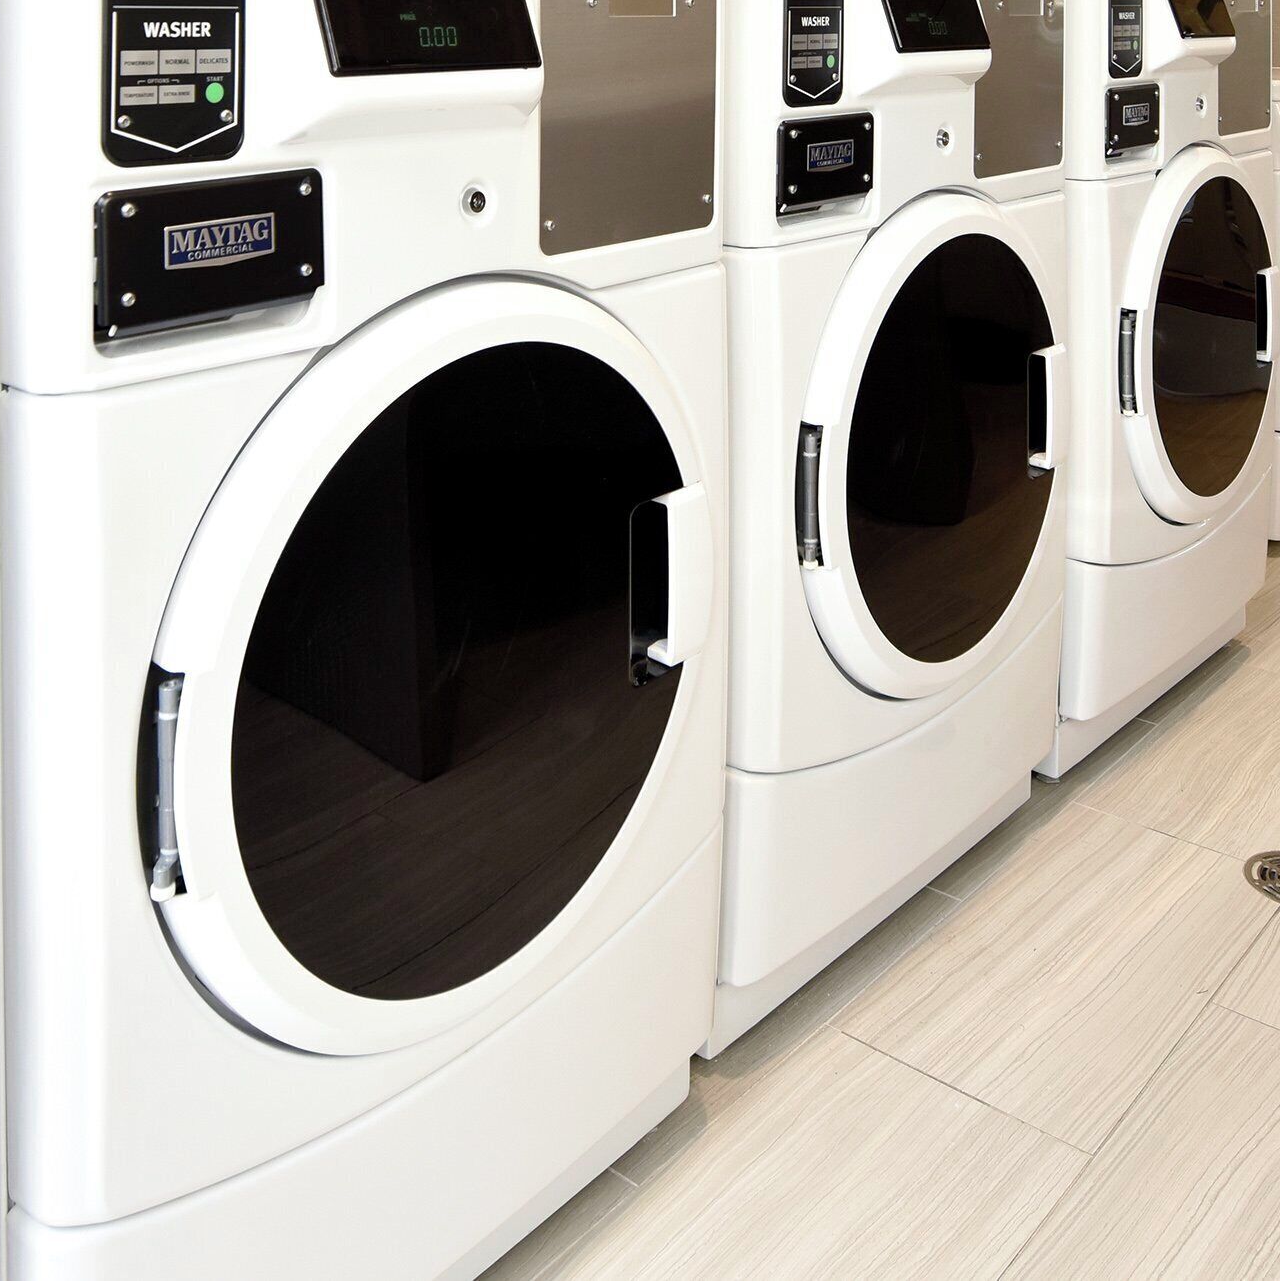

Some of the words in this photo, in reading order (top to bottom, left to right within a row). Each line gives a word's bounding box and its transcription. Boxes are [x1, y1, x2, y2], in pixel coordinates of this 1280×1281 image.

[801, 15, 830, 28] WASHER
[1119, 11, 1136, 21] WASHER
[143, 21, 212, 38] WASHER
[419, 26, 458, 47] 0.00
[1125, 104, 1150, 118] MAYTAG
[810, 143, 852, 162] MAYTAG
[171, 219, 269, 254] MAYTAG
[187, 242, 254, 261] COMMERCIAL
